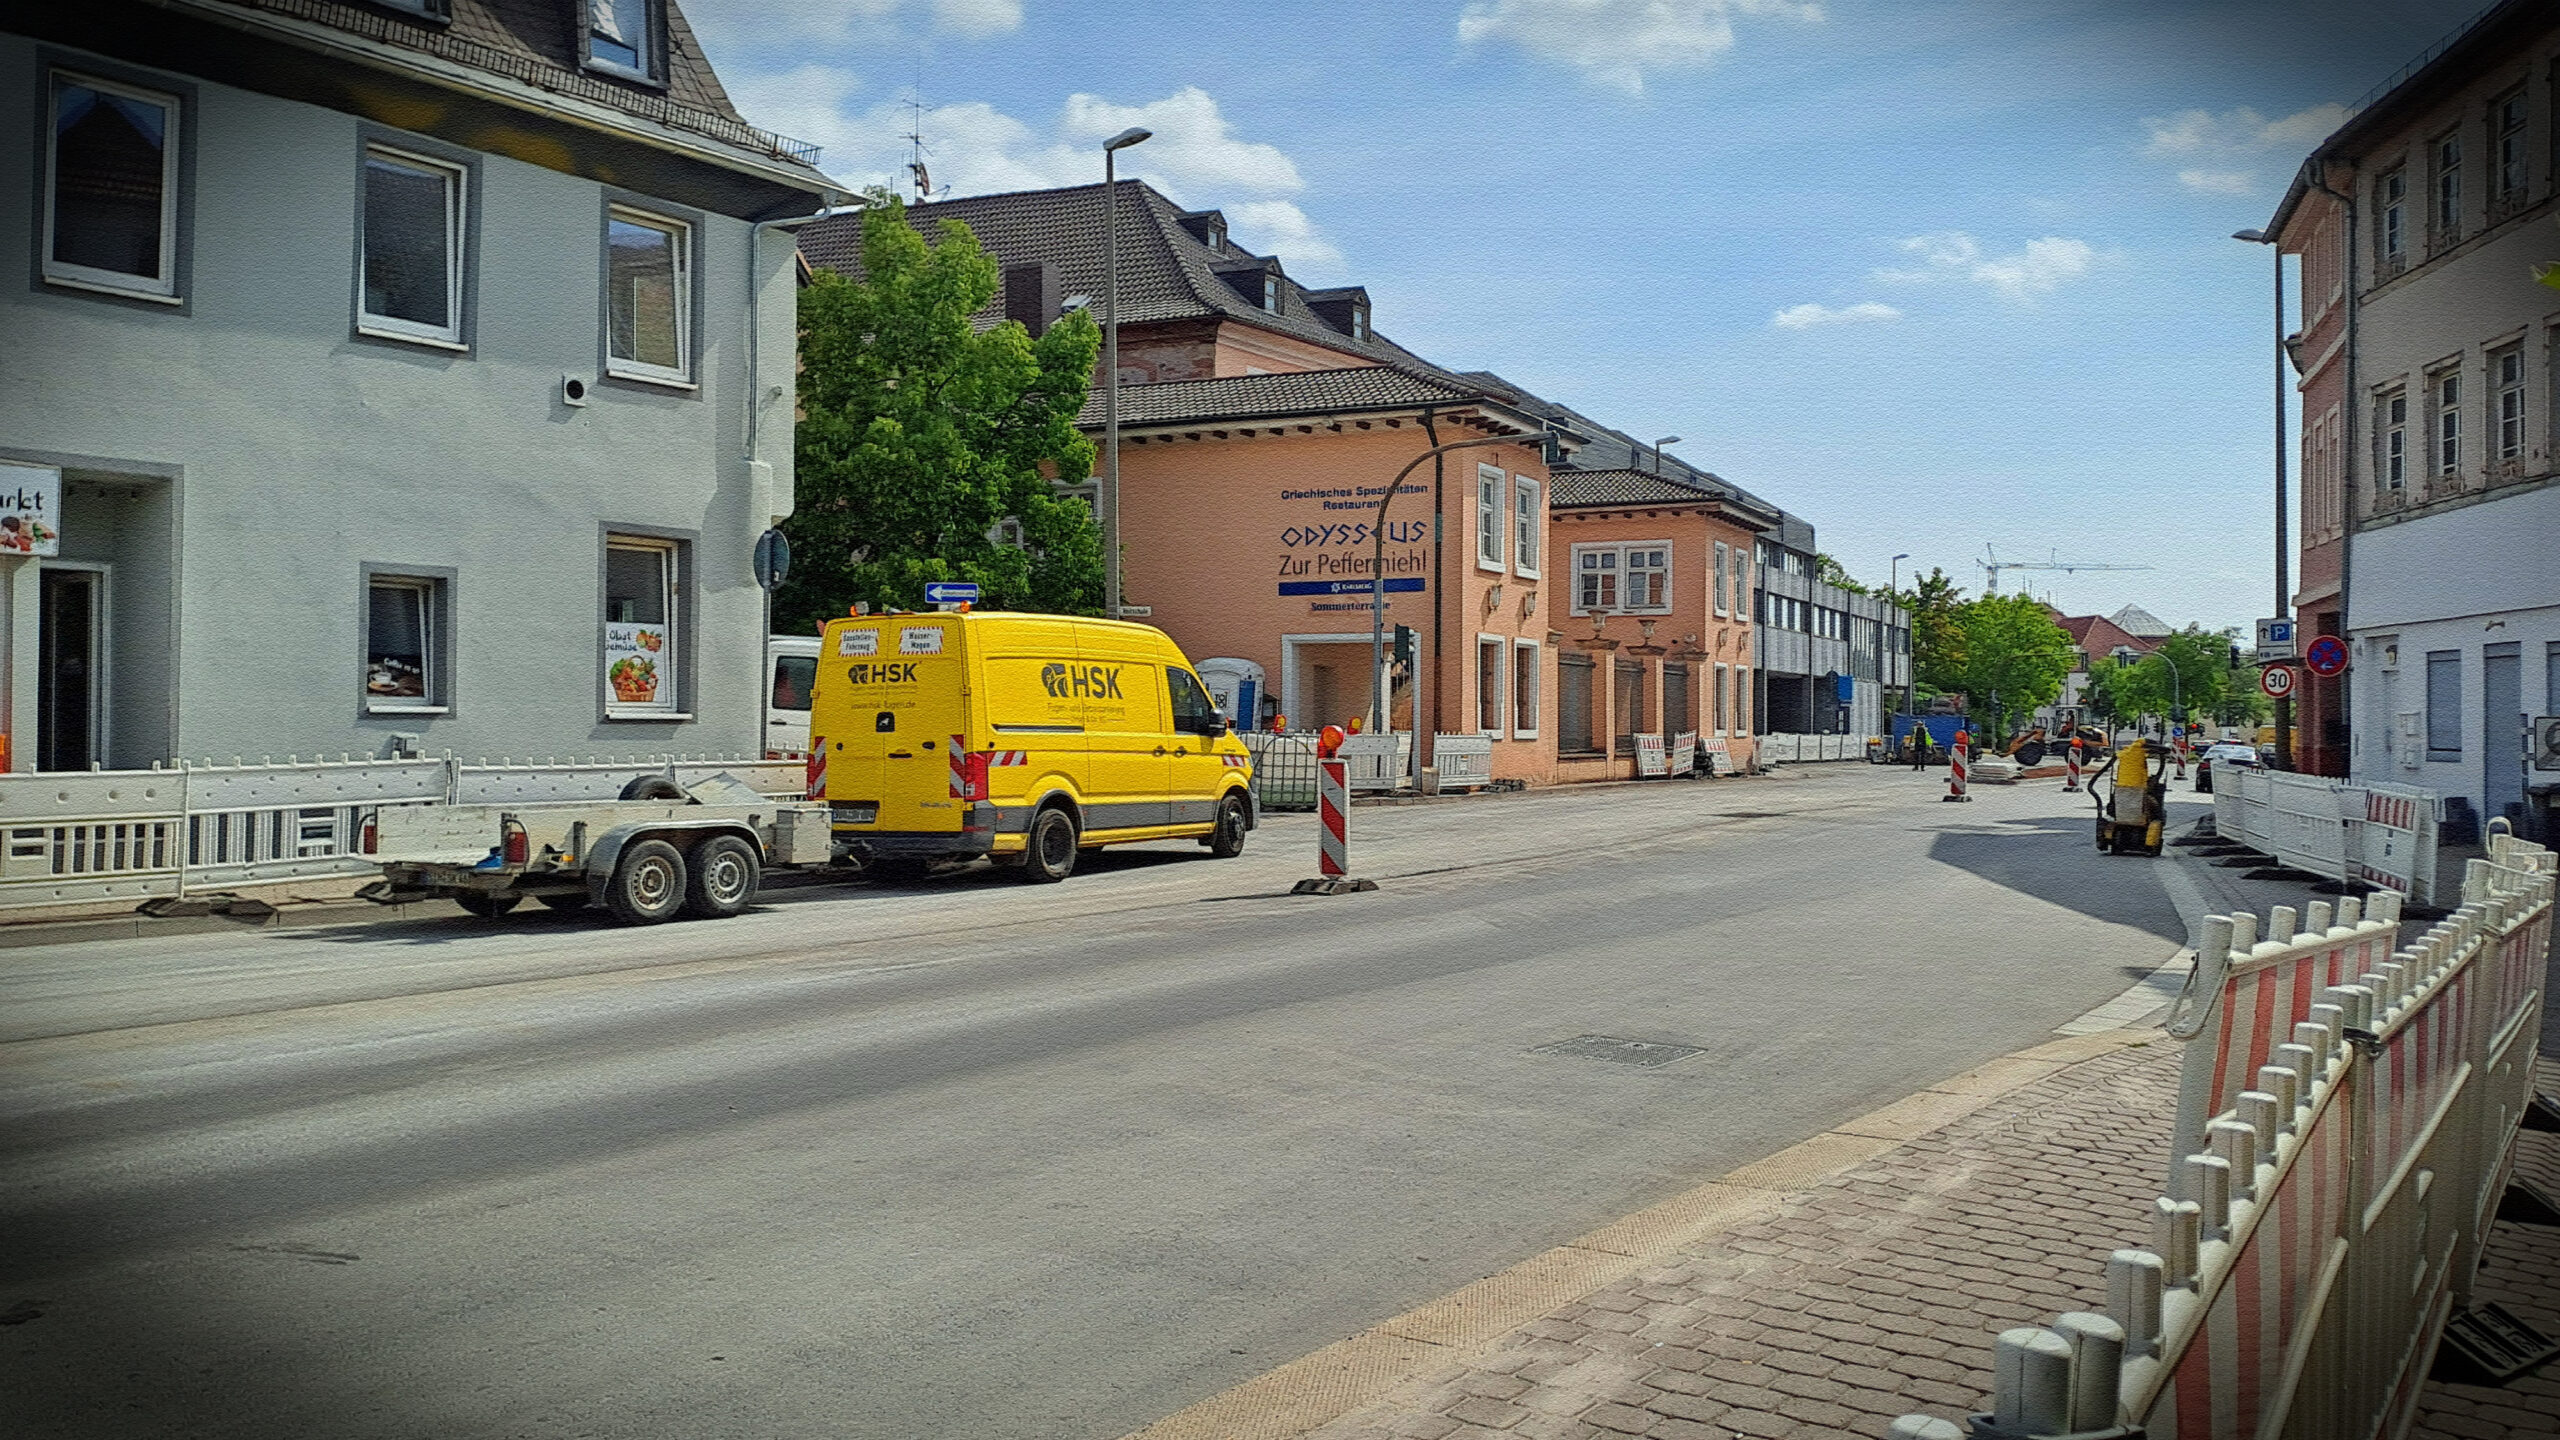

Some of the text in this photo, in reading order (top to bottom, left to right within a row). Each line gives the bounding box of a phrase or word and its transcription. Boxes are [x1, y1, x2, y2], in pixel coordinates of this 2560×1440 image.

[0, 487, 43, 511] rkt
[1281, 484, 1428, 499] Griechisches Spezilitäten
[1323, 500, 1385, 510] Restauran
[1279, 549, 1426, 576] Zur Peffermiehl
[1311, 602, 1391, 611] Sommerterrae
[2274, 626, 2285, 639] P
[871, 663, 918, 683] HSK
[2268, 673, 2288, 688] 30
[1070, 665, 1124, 699] HSK
